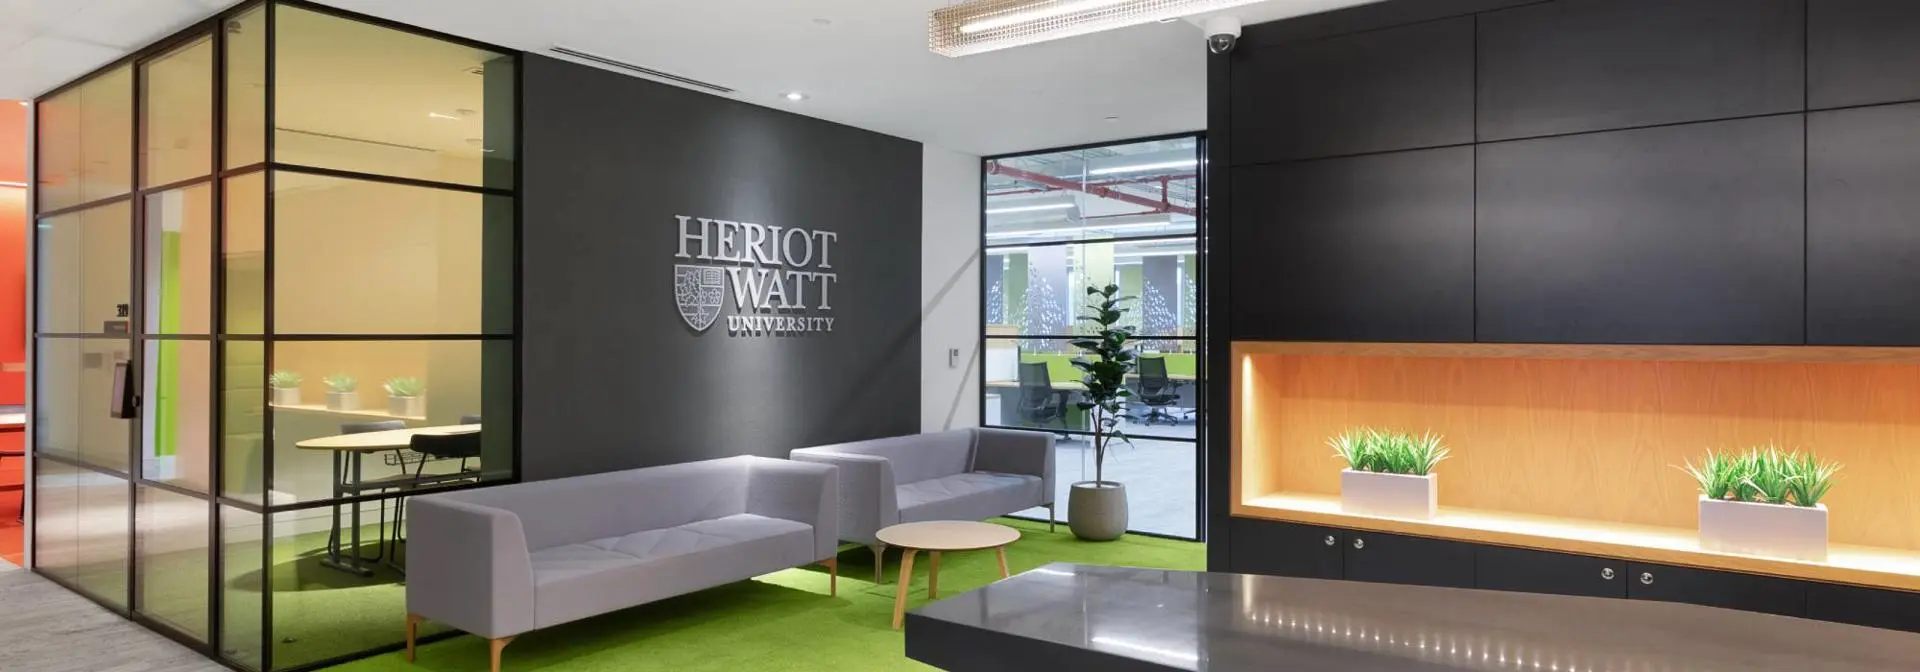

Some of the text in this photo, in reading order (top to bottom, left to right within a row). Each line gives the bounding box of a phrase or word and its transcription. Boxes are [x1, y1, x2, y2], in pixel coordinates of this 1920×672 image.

[674, 215, 837, 268] HERIOT
[726, 266, 837, 310] WATT
[727, 315, 834, 332] UNIVERSITY
